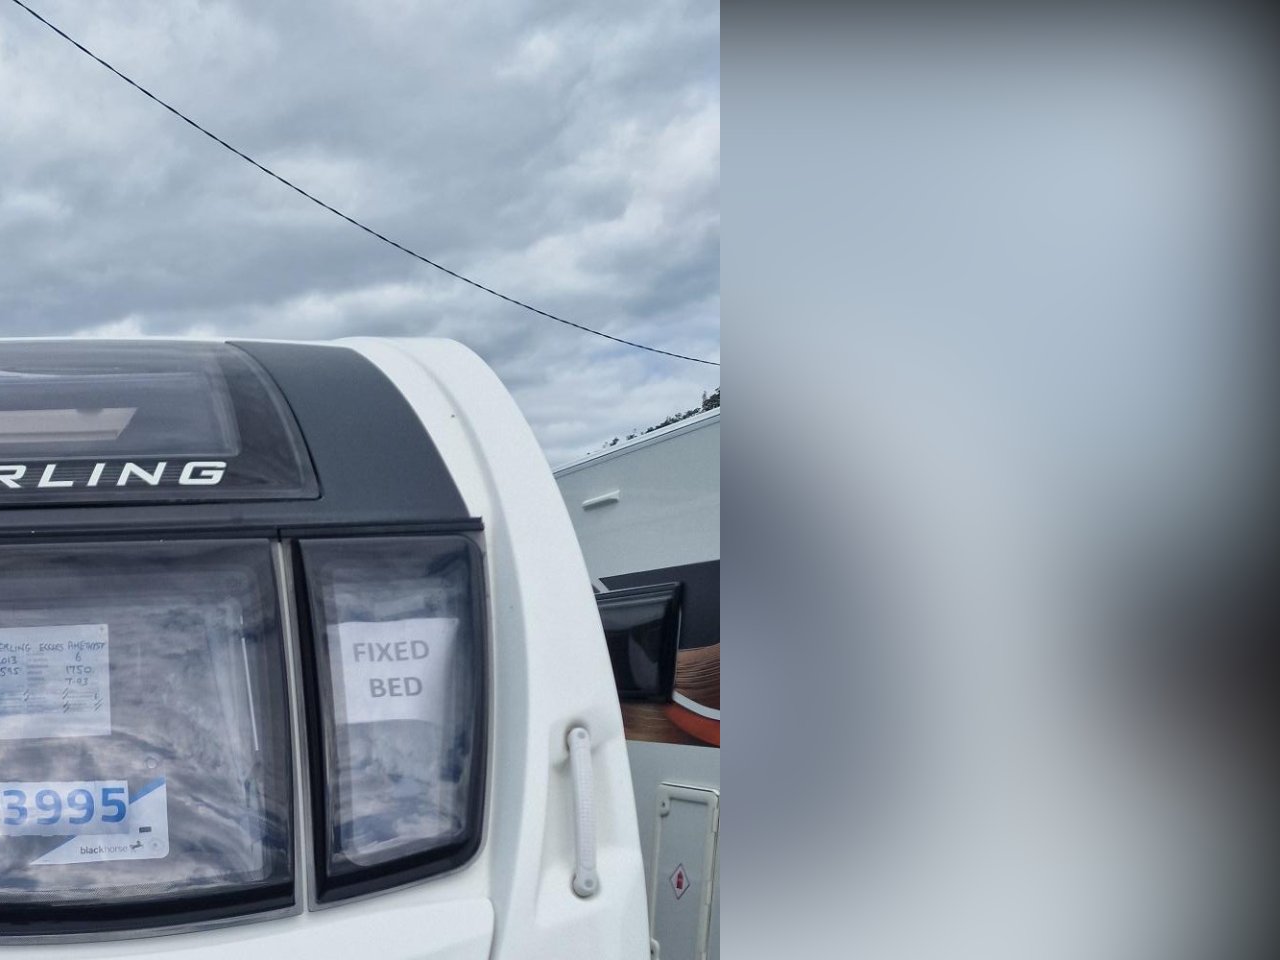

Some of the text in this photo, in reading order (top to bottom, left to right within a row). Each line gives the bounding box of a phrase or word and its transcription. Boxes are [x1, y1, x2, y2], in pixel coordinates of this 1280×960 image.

[75, 651, 82, 662] 6
[352, 640, 430, 662] FIXED
[369, 676, 424, 698] BED
